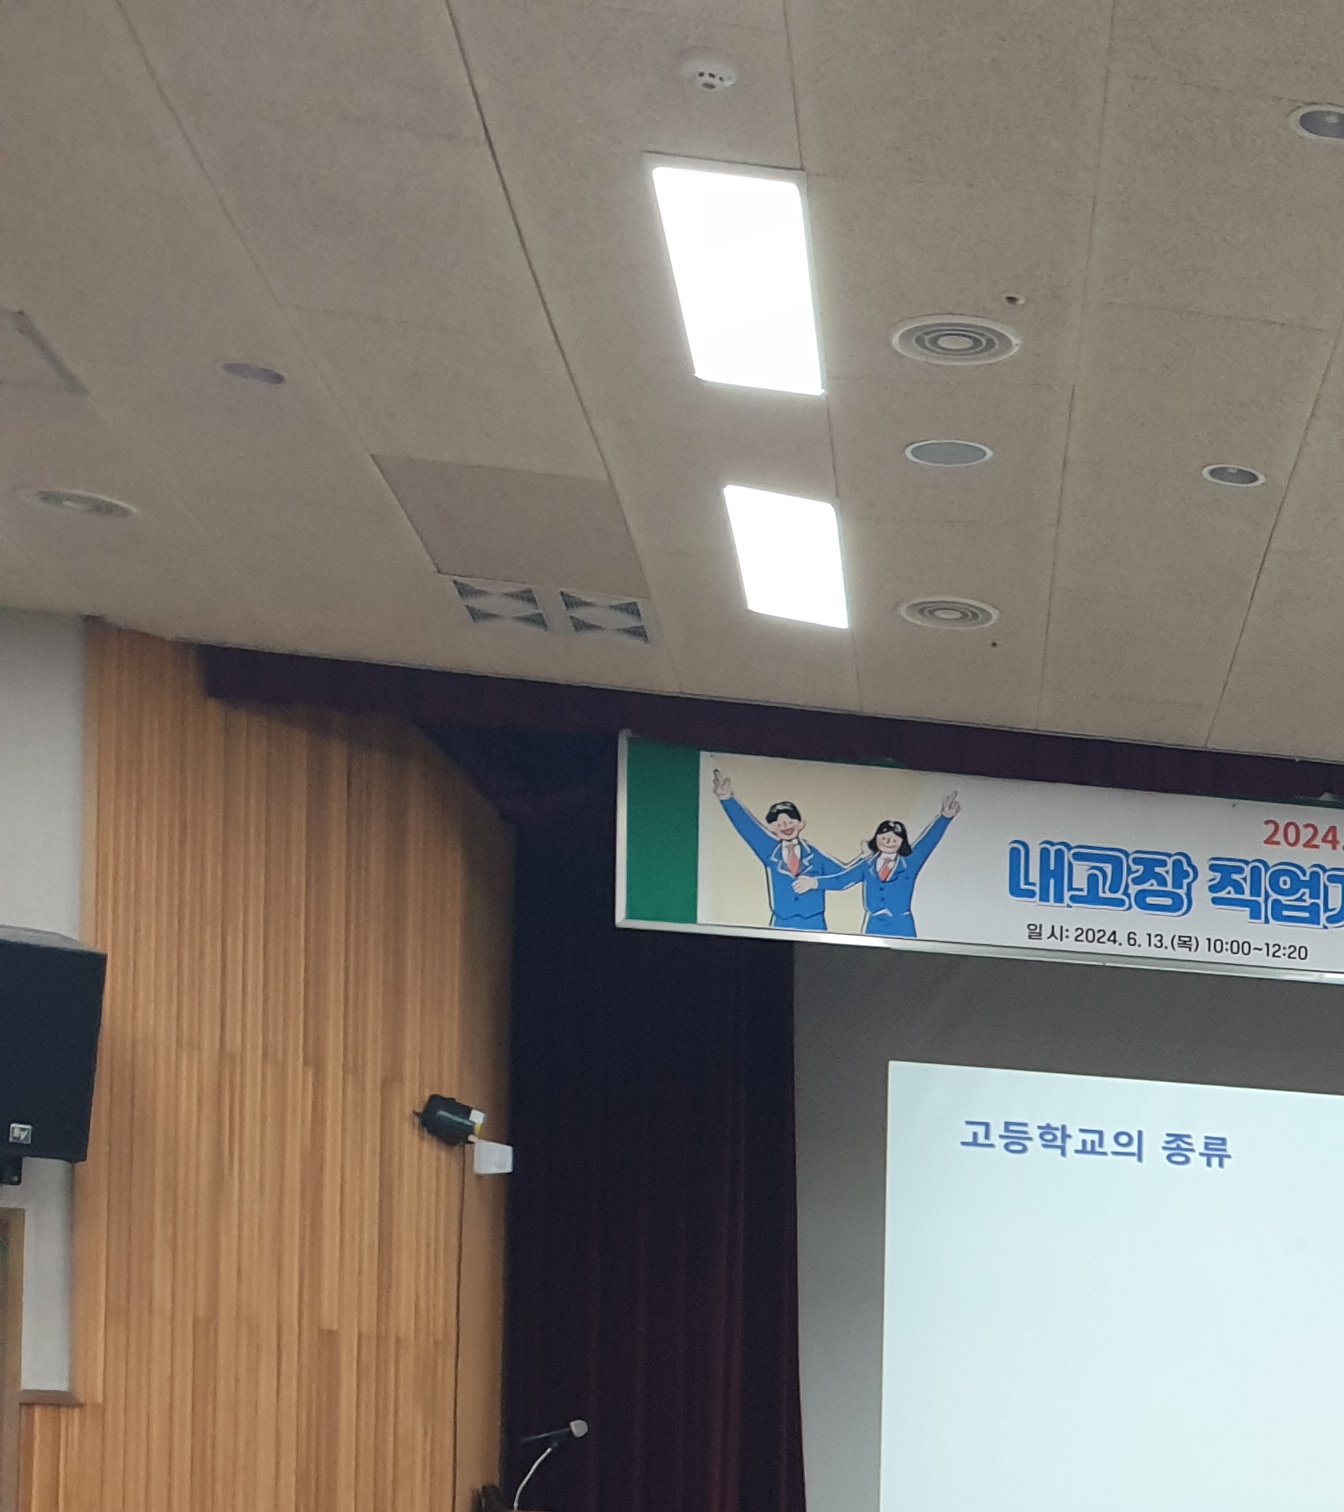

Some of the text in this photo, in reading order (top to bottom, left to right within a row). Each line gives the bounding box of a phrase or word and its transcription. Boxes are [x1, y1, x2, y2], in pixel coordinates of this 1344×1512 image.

[1008, 839, 1199, 918] 내고장
[1073, 926, 1122, 946] 2024.
[1126, 931, 1142, 948] 6.
[1205, 938, 1309, 961] 10:00~12:20
[960, 1119, 1232, 1169] 고등학교의 종류
